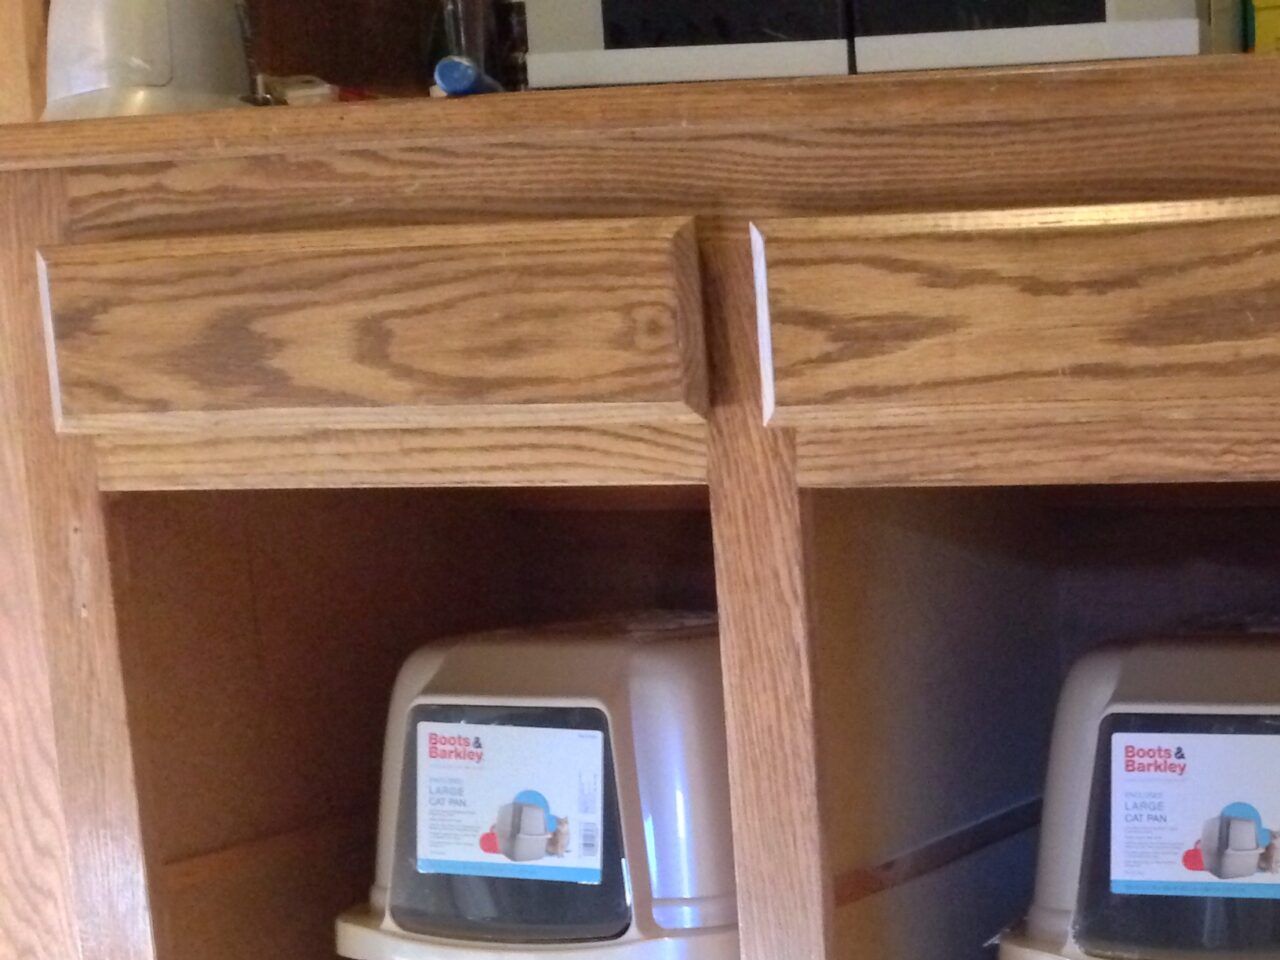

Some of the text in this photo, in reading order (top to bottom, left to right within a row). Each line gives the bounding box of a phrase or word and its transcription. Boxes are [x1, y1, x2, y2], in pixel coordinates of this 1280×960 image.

[428, 732, 482, 749] Boots &
[428, 746, 484, 763] Barkley
[1124, 745, 1186, 760] Boots &
[1124, 759, 1187, 776] Barkley
[429, 785, 465, 797] LARGE
[429, 797, 467, 808] CAT PAN
[1124, 802, 1165, 811] LARGE
[1124, 813, 1167, 823] CAT PAN
